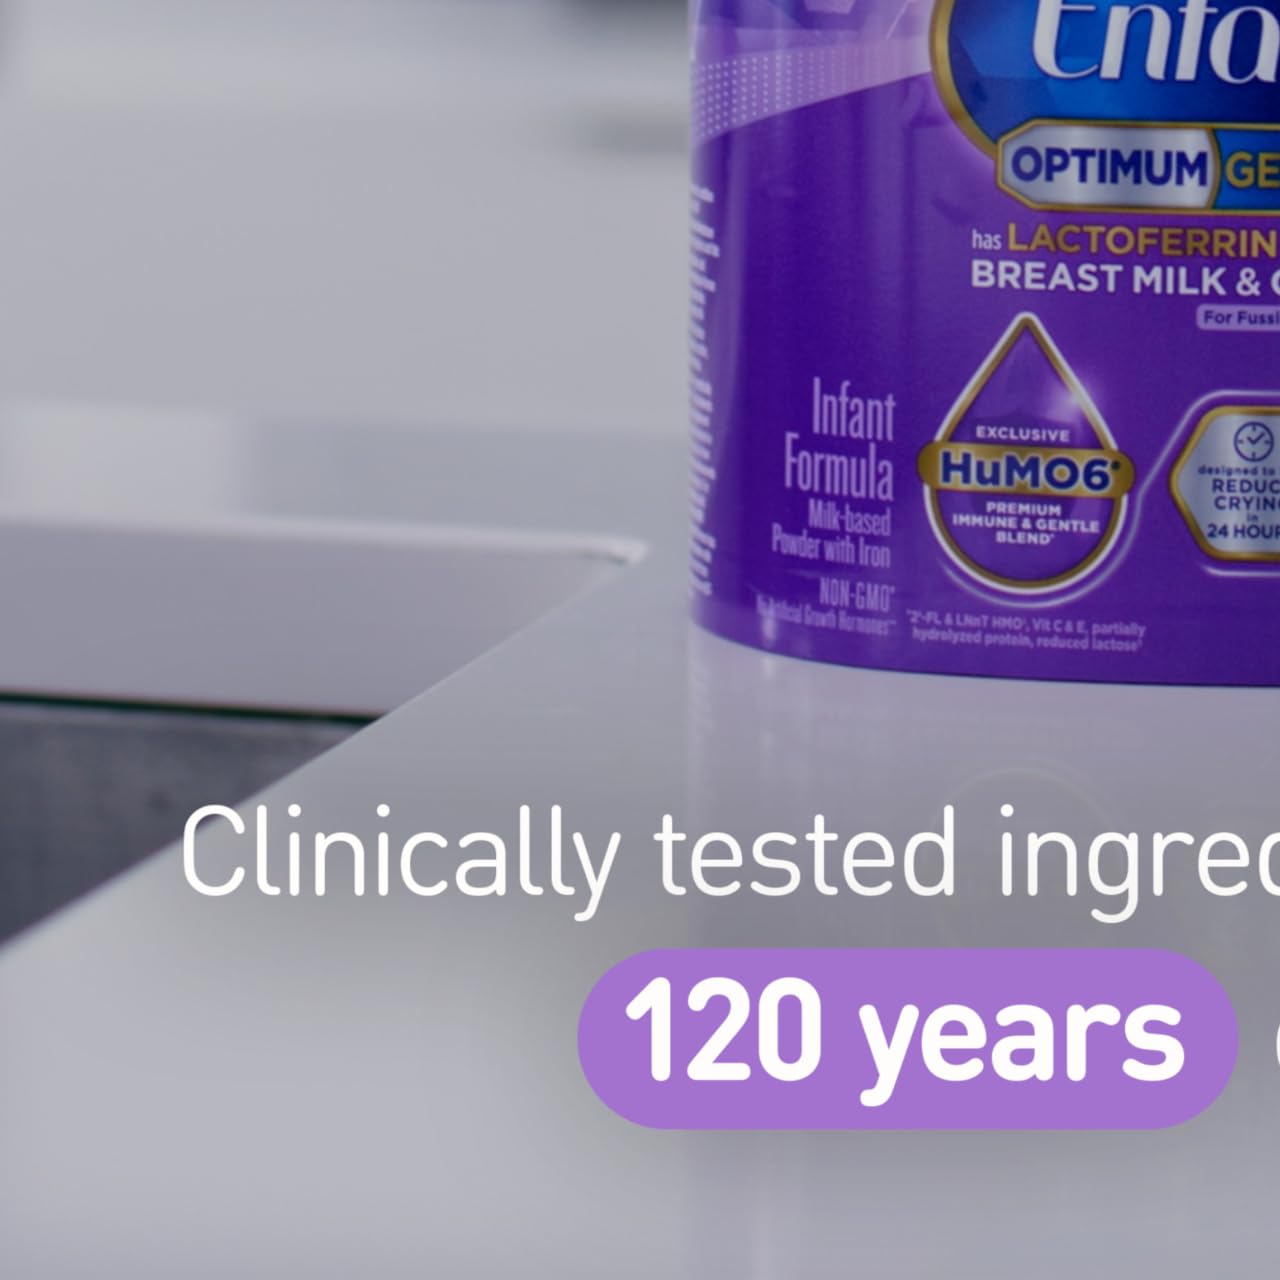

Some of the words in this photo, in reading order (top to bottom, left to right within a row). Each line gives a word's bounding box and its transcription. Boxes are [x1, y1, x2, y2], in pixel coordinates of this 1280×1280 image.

[1011, 145, 1208, 187] OPTIMUM
[971, 228, 1002, 250] has
[1007, 222, 1278, 258] LACTOFERRIN
[971, 259, 1123, 293] BREAST
[1132, 265, 1227, 295] MILK
[1236, 267, 1261, 296] &
[1203, 309, 1232, 325] For
[812, 376, 896, 442] Infant
[975, 424, 1070, 442] EXCLUSIVE
[785, 430, 894, 502] Formula
[808, 497, 891, 537] Milk-based
[952, 514, 1018, 529] IMMUNE
[1021, 517, 1033, 530] &
[1035, 518, 1100, 533] GENTLE
[985, 501, 1062, 516] PREMIUM
[771, 522, 821, 561] Powder
[823, 536, 855, 565] with
[858, 536, 891, 569] Iron
[1206, 523, 1228, 538] 24
